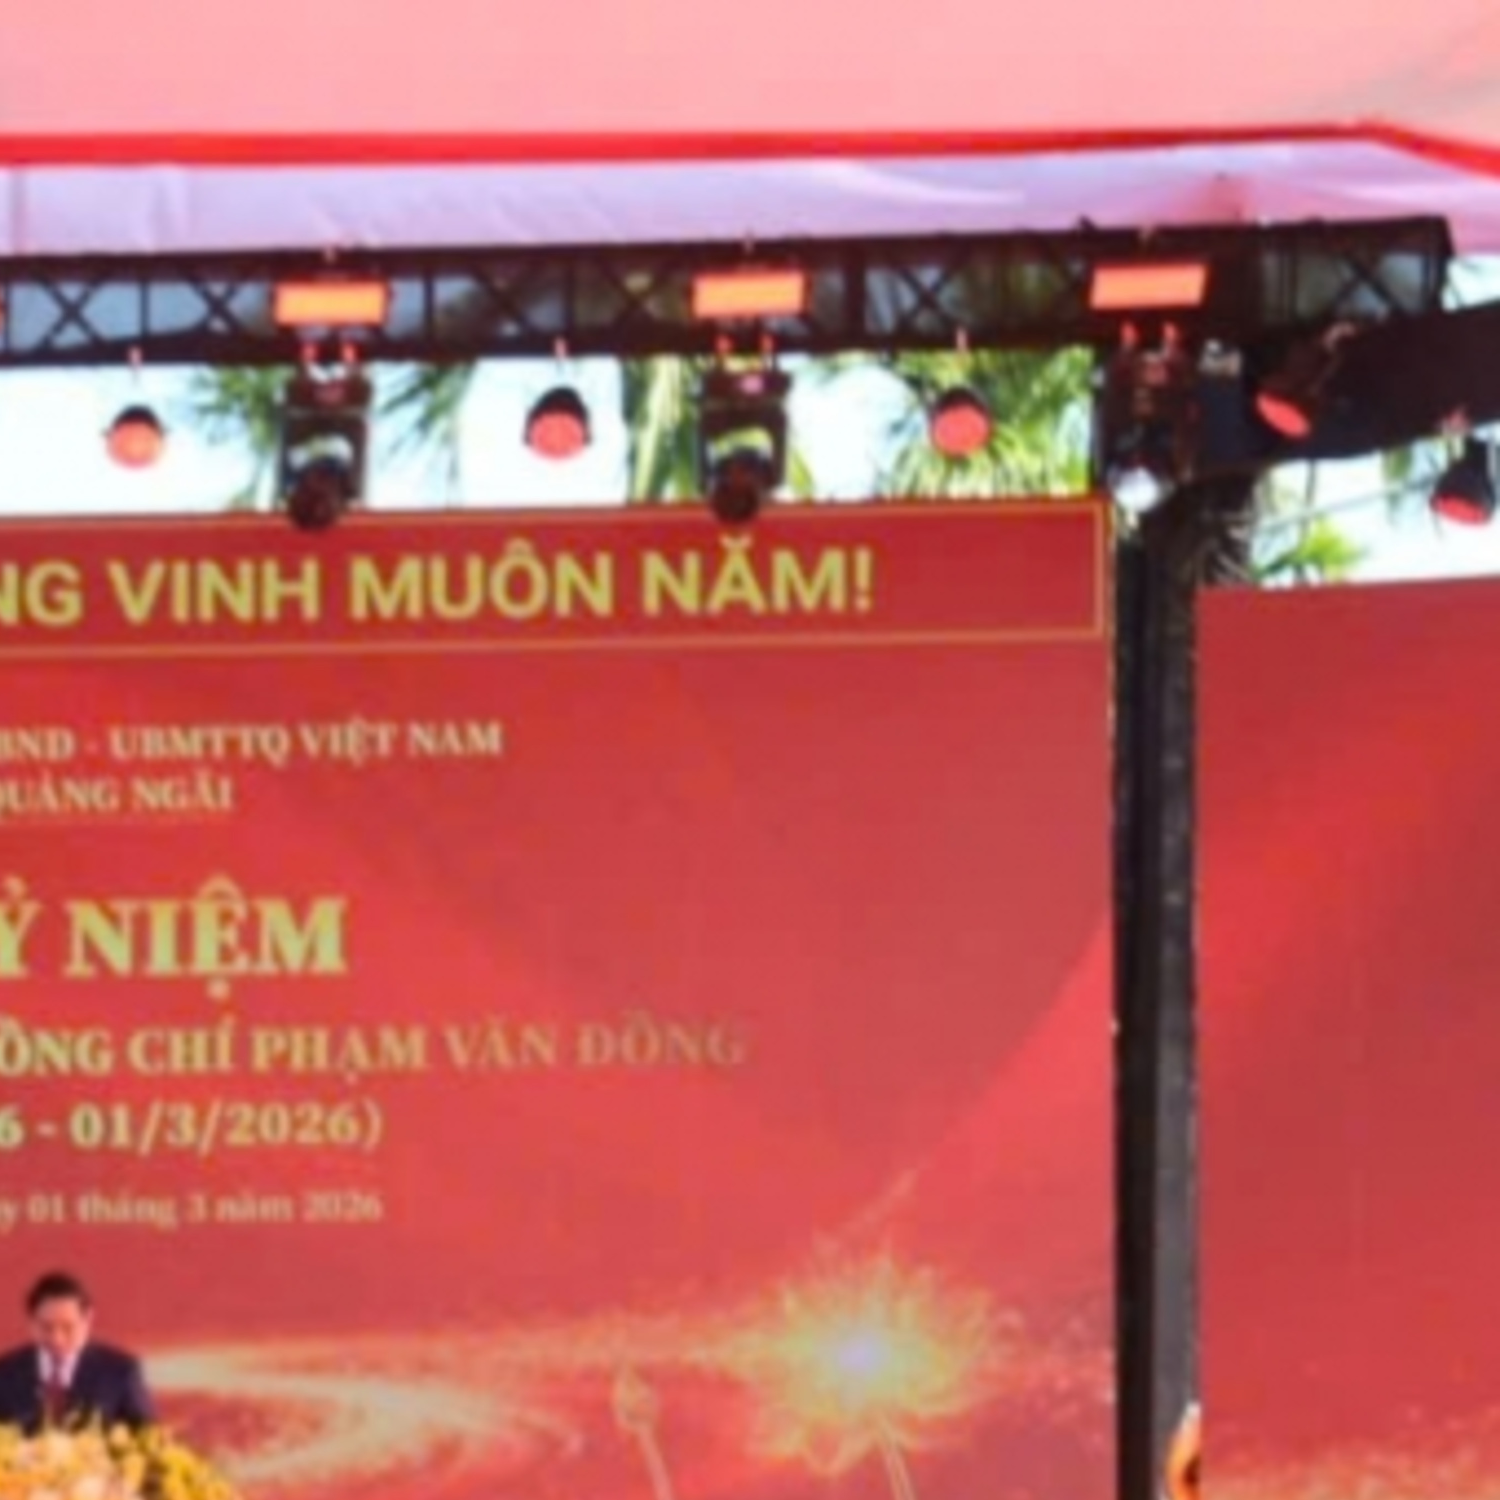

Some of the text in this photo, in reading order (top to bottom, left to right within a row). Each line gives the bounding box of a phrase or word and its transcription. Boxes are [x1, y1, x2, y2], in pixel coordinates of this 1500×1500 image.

[108, 555, 321, 624] VINH
[350, 538, 613, 621] MUÔN
[641, 534, 876, 616] NĂM!
[110, 724, 290, 768] UBMTTQ
[300, 715, 397, 767] VIỆT
[409, 720, 503, 758] NAM
[64, 876, 347, 1000] NIỆM
[128, 1015, 236, 1075] CHÍ
[253, 1026, 428, 1086] PHẠM
[70, 1098, 384, 1158] 01/3/2026)
[27, 1195, 65, 1224] 01
[303, 1192, 384, 1224] 2026
